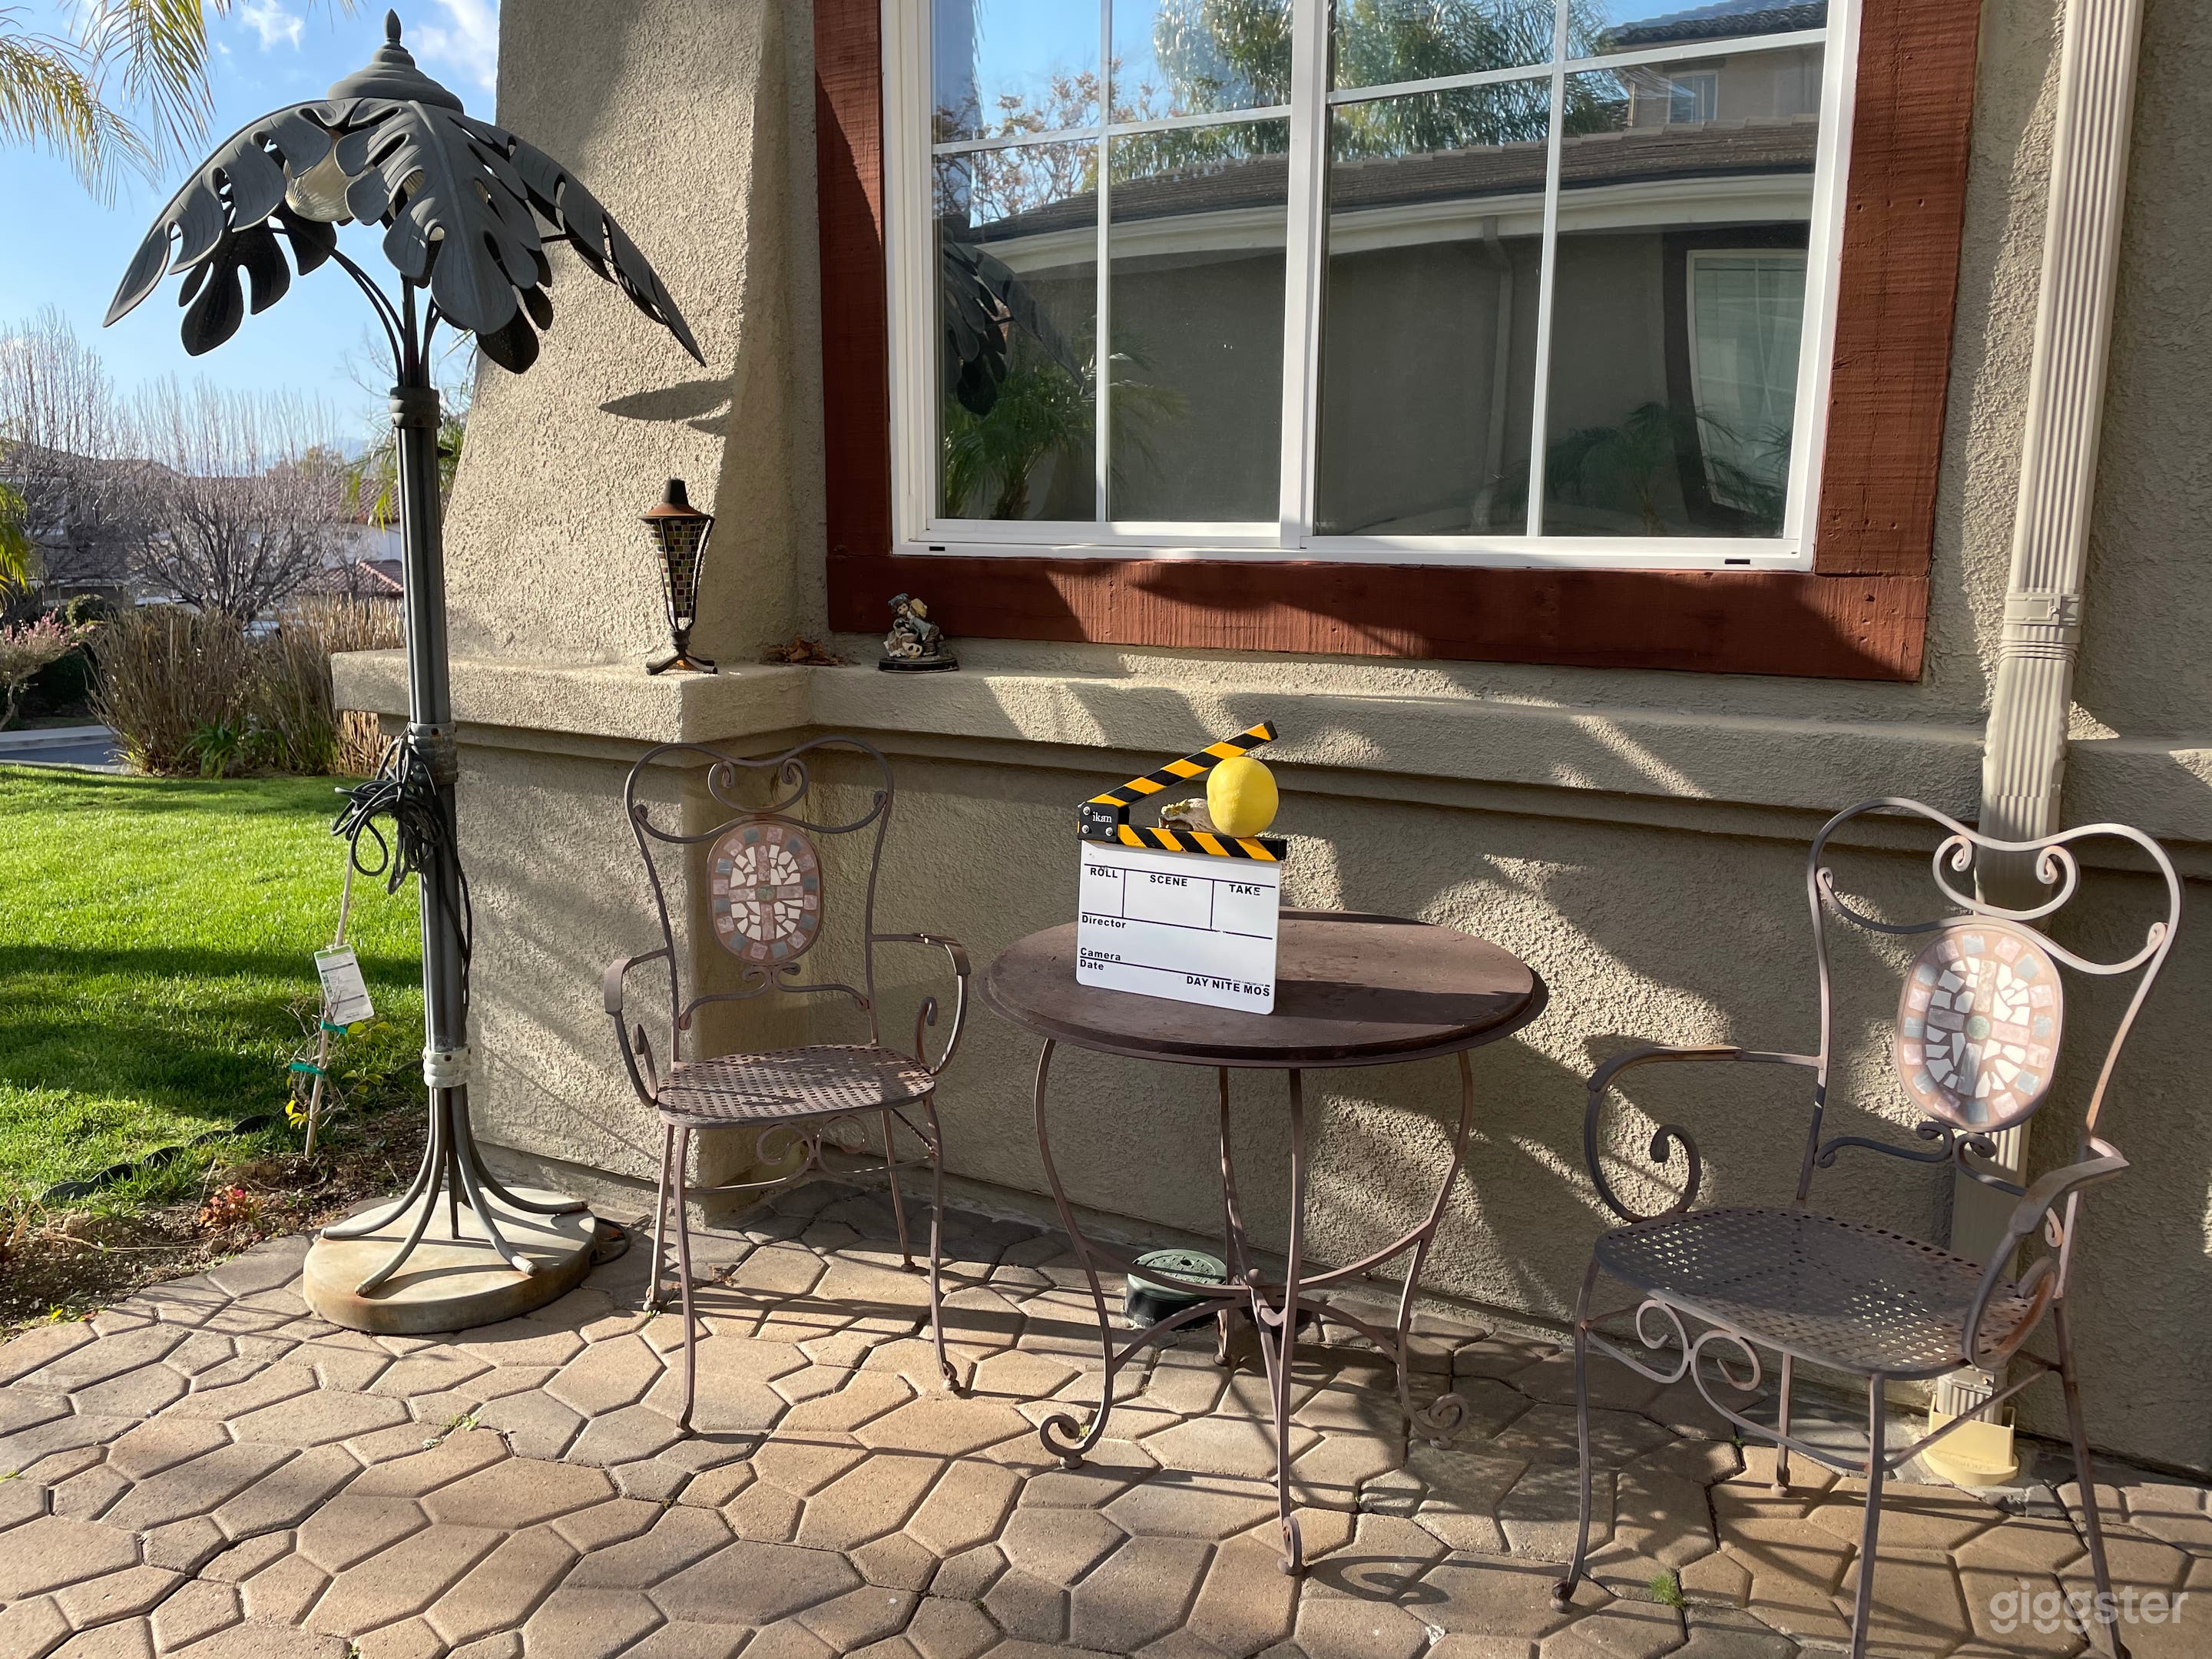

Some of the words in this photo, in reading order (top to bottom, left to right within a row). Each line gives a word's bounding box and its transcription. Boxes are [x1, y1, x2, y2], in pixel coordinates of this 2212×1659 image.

[1092, 811, 1112, 823] ikan
[1090, 867, 1118, 879] ROLL
[1150, 875, 1187, 887] SCENE
[1229, 884, 1261, 896] TAKE
[1082, 915, 1126, 929] Director
[1081, 948, 1121, 961] Camera
[1080, 959, 1104, 971] Date
[1186, 975, 1209, 987] DAY
[1212, 979, 1240, 992] NITE
[1243, 984, 1271, 997] MOS
